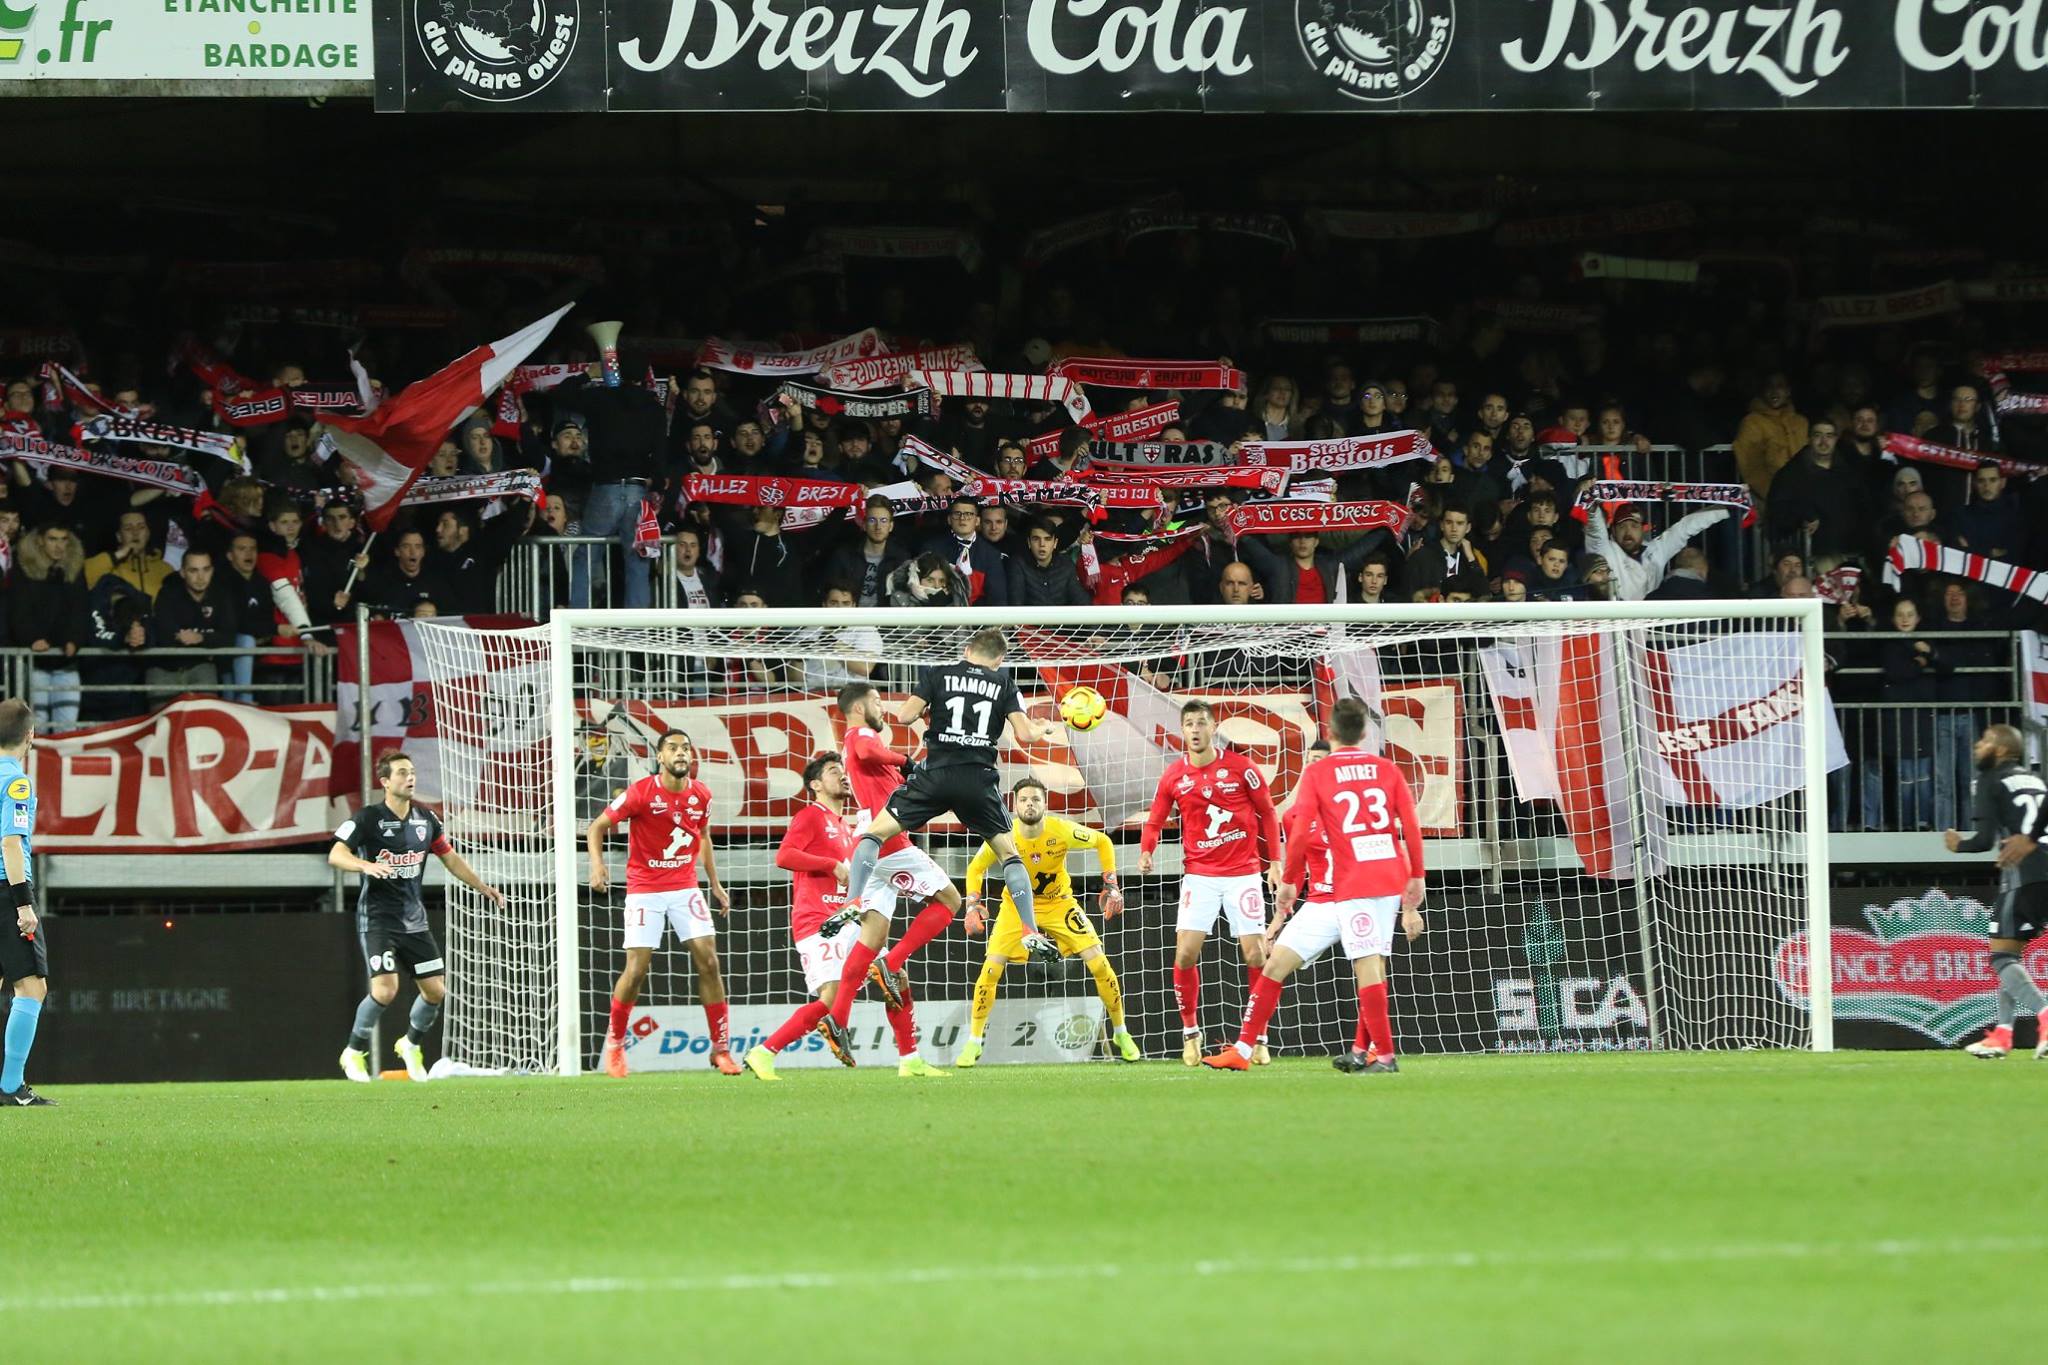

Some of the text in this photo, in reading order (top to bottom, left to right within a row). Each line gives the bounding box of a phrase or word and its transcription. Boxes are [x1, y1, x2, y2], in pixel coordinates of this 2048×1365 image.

[1025, 0, 1254, 76] Cola
[1894, 0, 2048, 72] Col
[203, 43, 358, 68] BARDAGE
[424, 13, 575, 90] du phare ouest
[1304, 15, 1451, 90] du phare ouest
[843, 400, 909, 418] KEMPER
[1112, 408, 1180, 438] BRESTOIS
[1290, 443, 1395, 473] Brestois
[1309, 438, 1360, 457] Stade
[699, 479, 749, 494] ALLEZ
[943, 675, 1001, 701] TRAMONI
[945, 696, 993, 739] 11
[1334, 764, 1379, 784] AUTRET
[1333, 787, 1391, 834] 23
[382, 950, 396, 972] 6
[1902, 954, 1928, 982] de
[1011, 1021, 1038, 1047] 2
